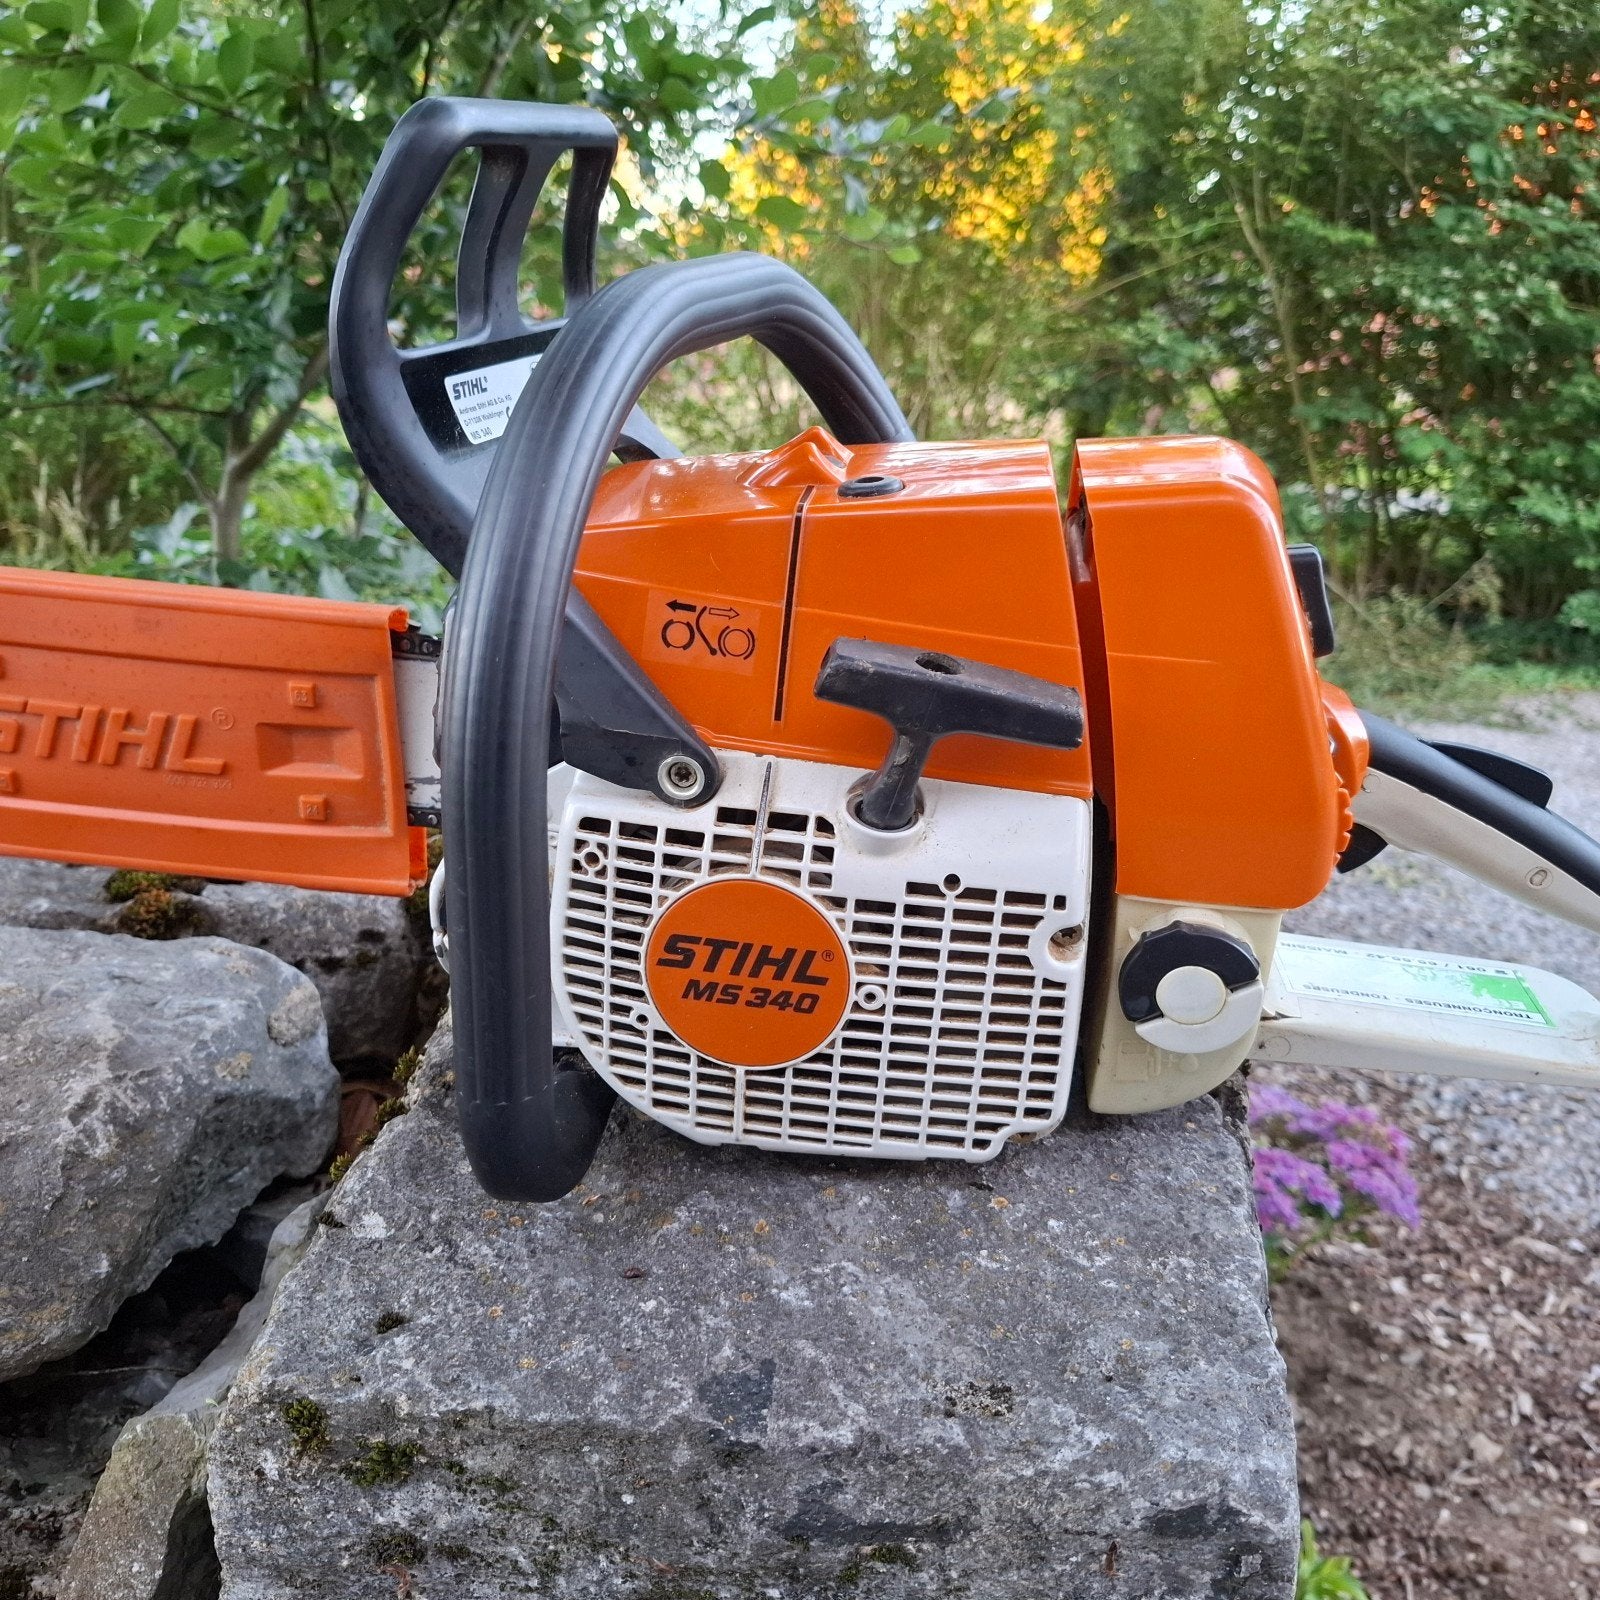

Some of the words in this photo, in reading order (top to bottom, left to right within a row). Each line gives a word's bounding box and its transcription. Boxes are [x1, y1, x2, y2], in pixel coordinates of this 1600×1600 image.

[470, 430, 481, 440] MS
[482, 427, 493, 437] 340
[681, 978, 743, 1005] MS
[745, 987, 820, 1015] 340
[1404, 997, 1533, 1020] TRONÇONNEUSES
